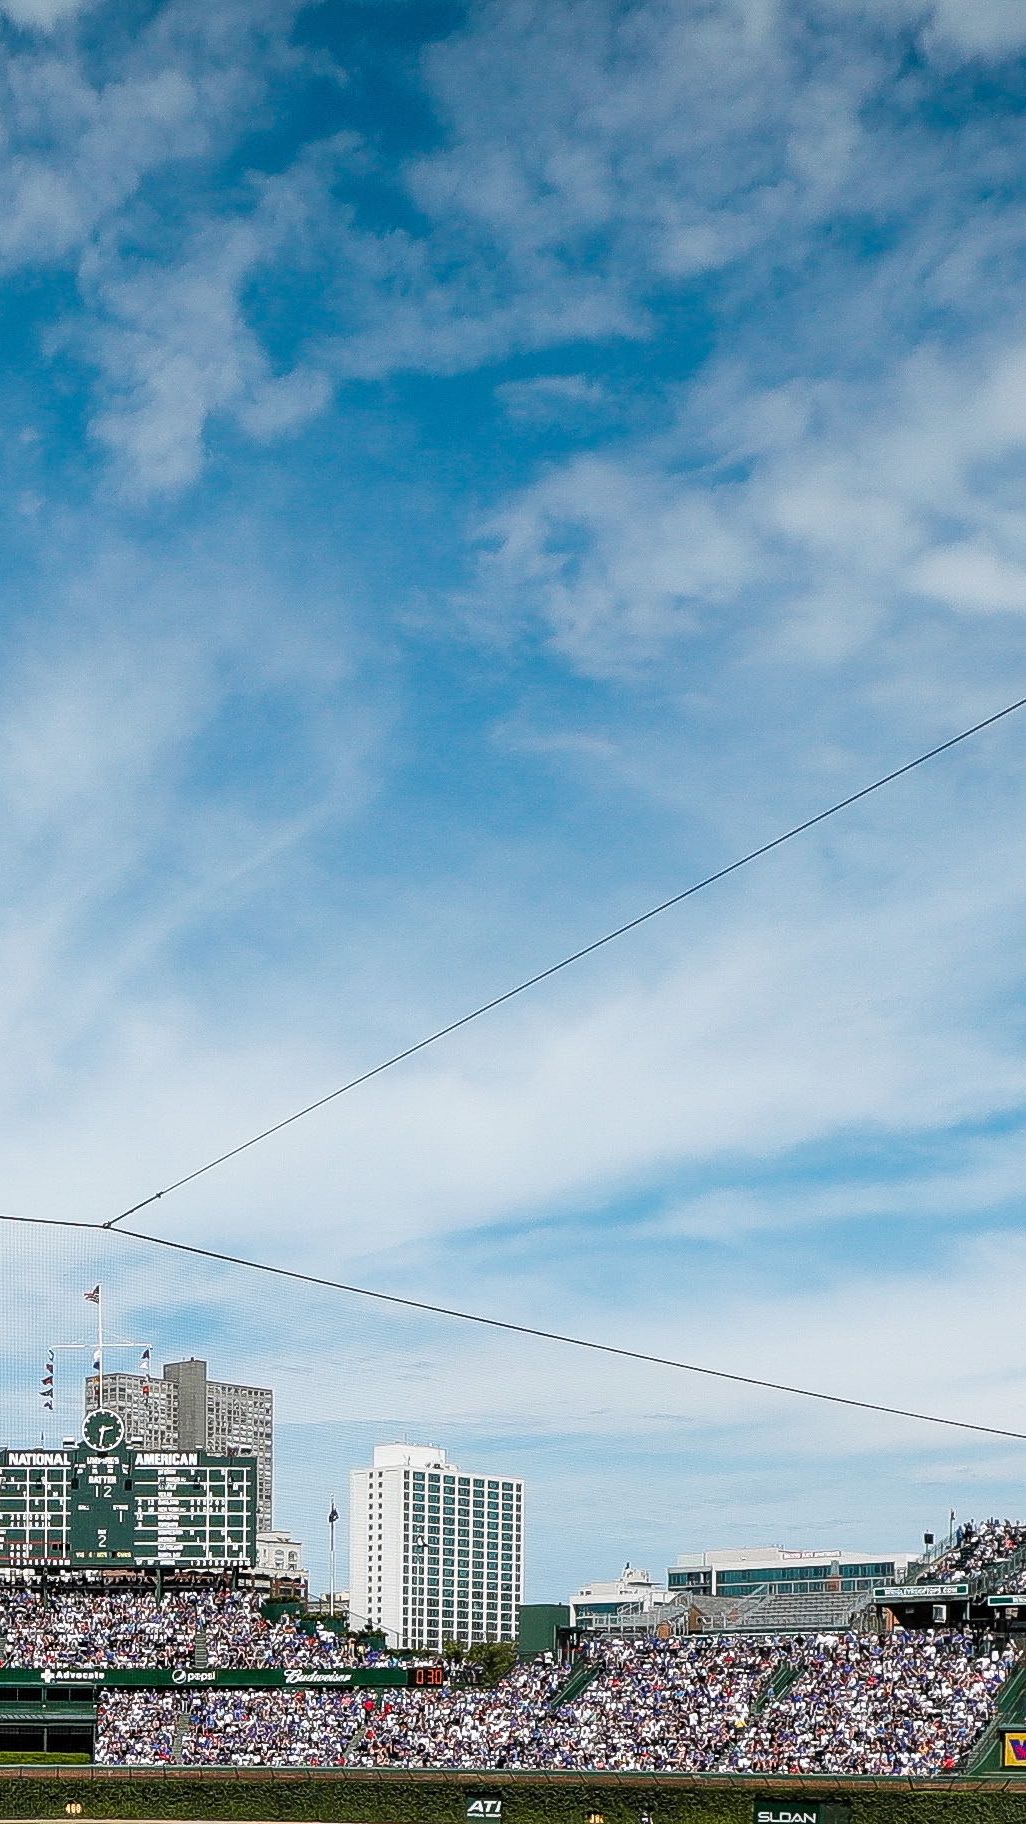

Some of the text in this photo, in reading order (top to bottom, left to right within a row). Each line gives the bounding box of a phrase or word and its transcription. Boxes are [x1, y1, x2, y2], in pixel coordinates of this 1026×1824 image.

[8, 1453, 71, 1466] NATIONAL
[135, 1453, 197, 1466] AMERICAN
[95, 1485, 112, 1497] 12
[98, 1535, 106, 1547] 2
[55, 1670, 105, 1679] Advocate
[187, 1670, 216, 1682] pepsi
[284, 1669, 352, 1683] Budweiser
[467, 1800, 502, 1812] ATI
[757, 1811, 817, 1824] SLOAN
